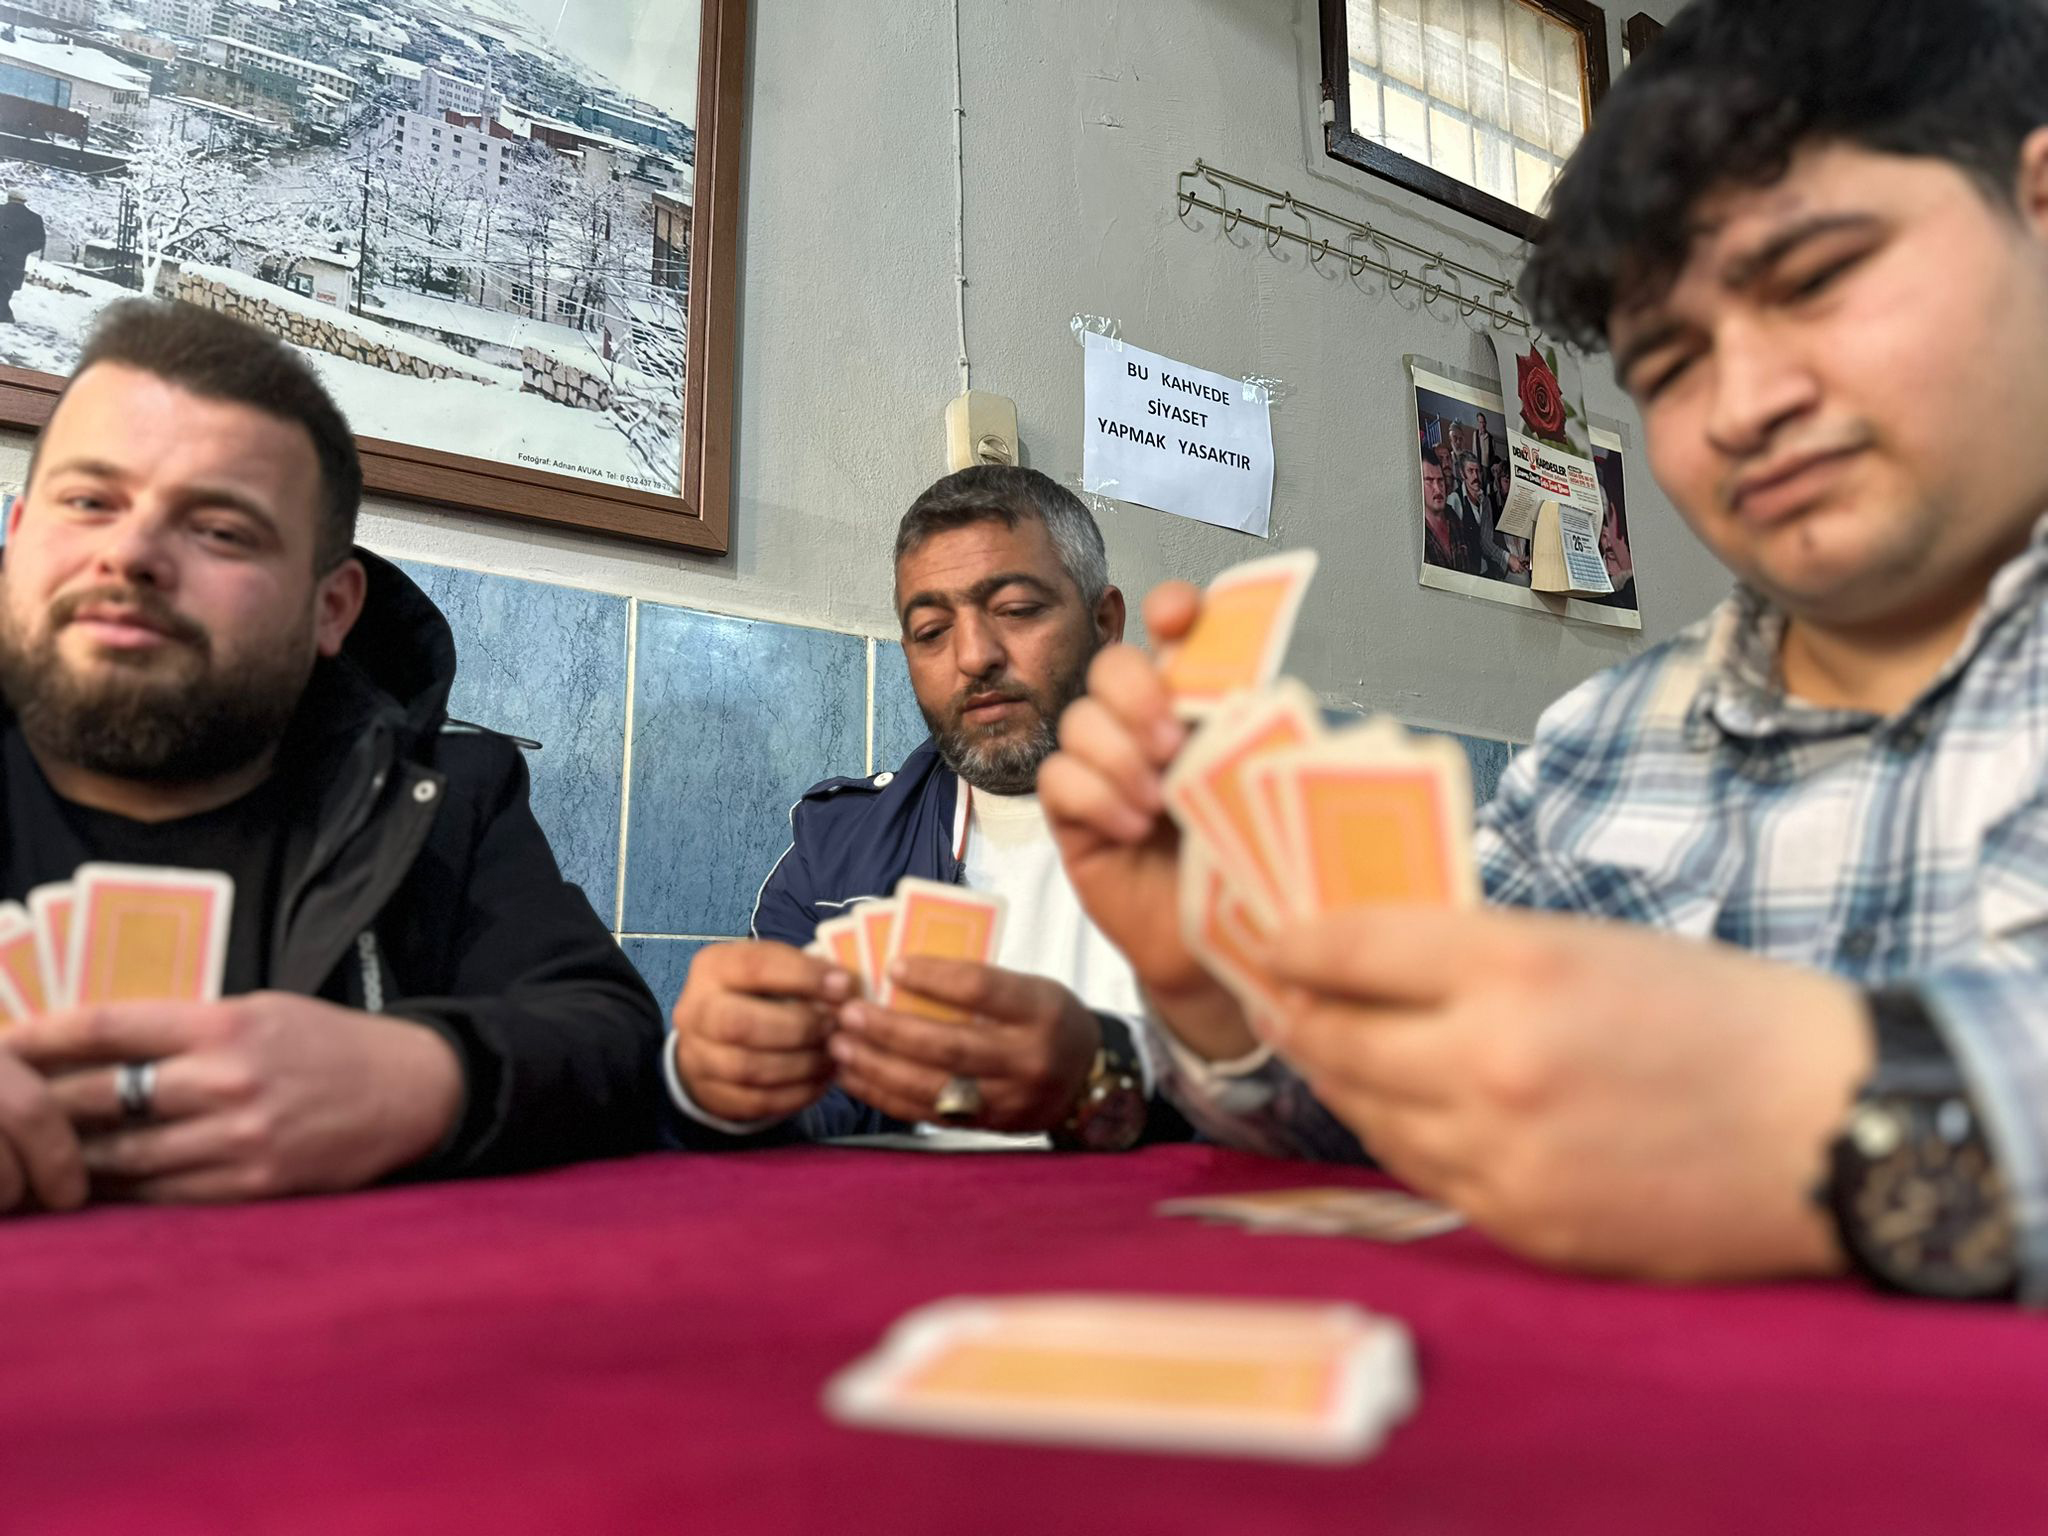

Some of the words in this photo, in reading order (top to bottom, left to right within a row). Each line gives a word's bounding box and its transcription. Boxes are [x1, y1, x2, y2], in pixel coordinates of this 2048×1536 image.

[1127, 361, 1149, 381] BU
[1161, 372, 1231, 406] KAHVEDE
[1147, 398, 1209, 428] SİYASET
[1097, 417, 1167, 450] YAPMAK
[1178, 438, 1251, 471] YASAKTIR
[517, 452, 552, 466] Fotoğraf:
[552, 459, 577, 472] Adnan
[577, 465, 603, 477] AVUKA
[606, 470, 619, 480] Tel:
[619, 474, 625, 482] 0
[625, 475, 639, 485] 532
[639, 478, 652, 488] 437
[1572, 534, 1584, 553] 26
